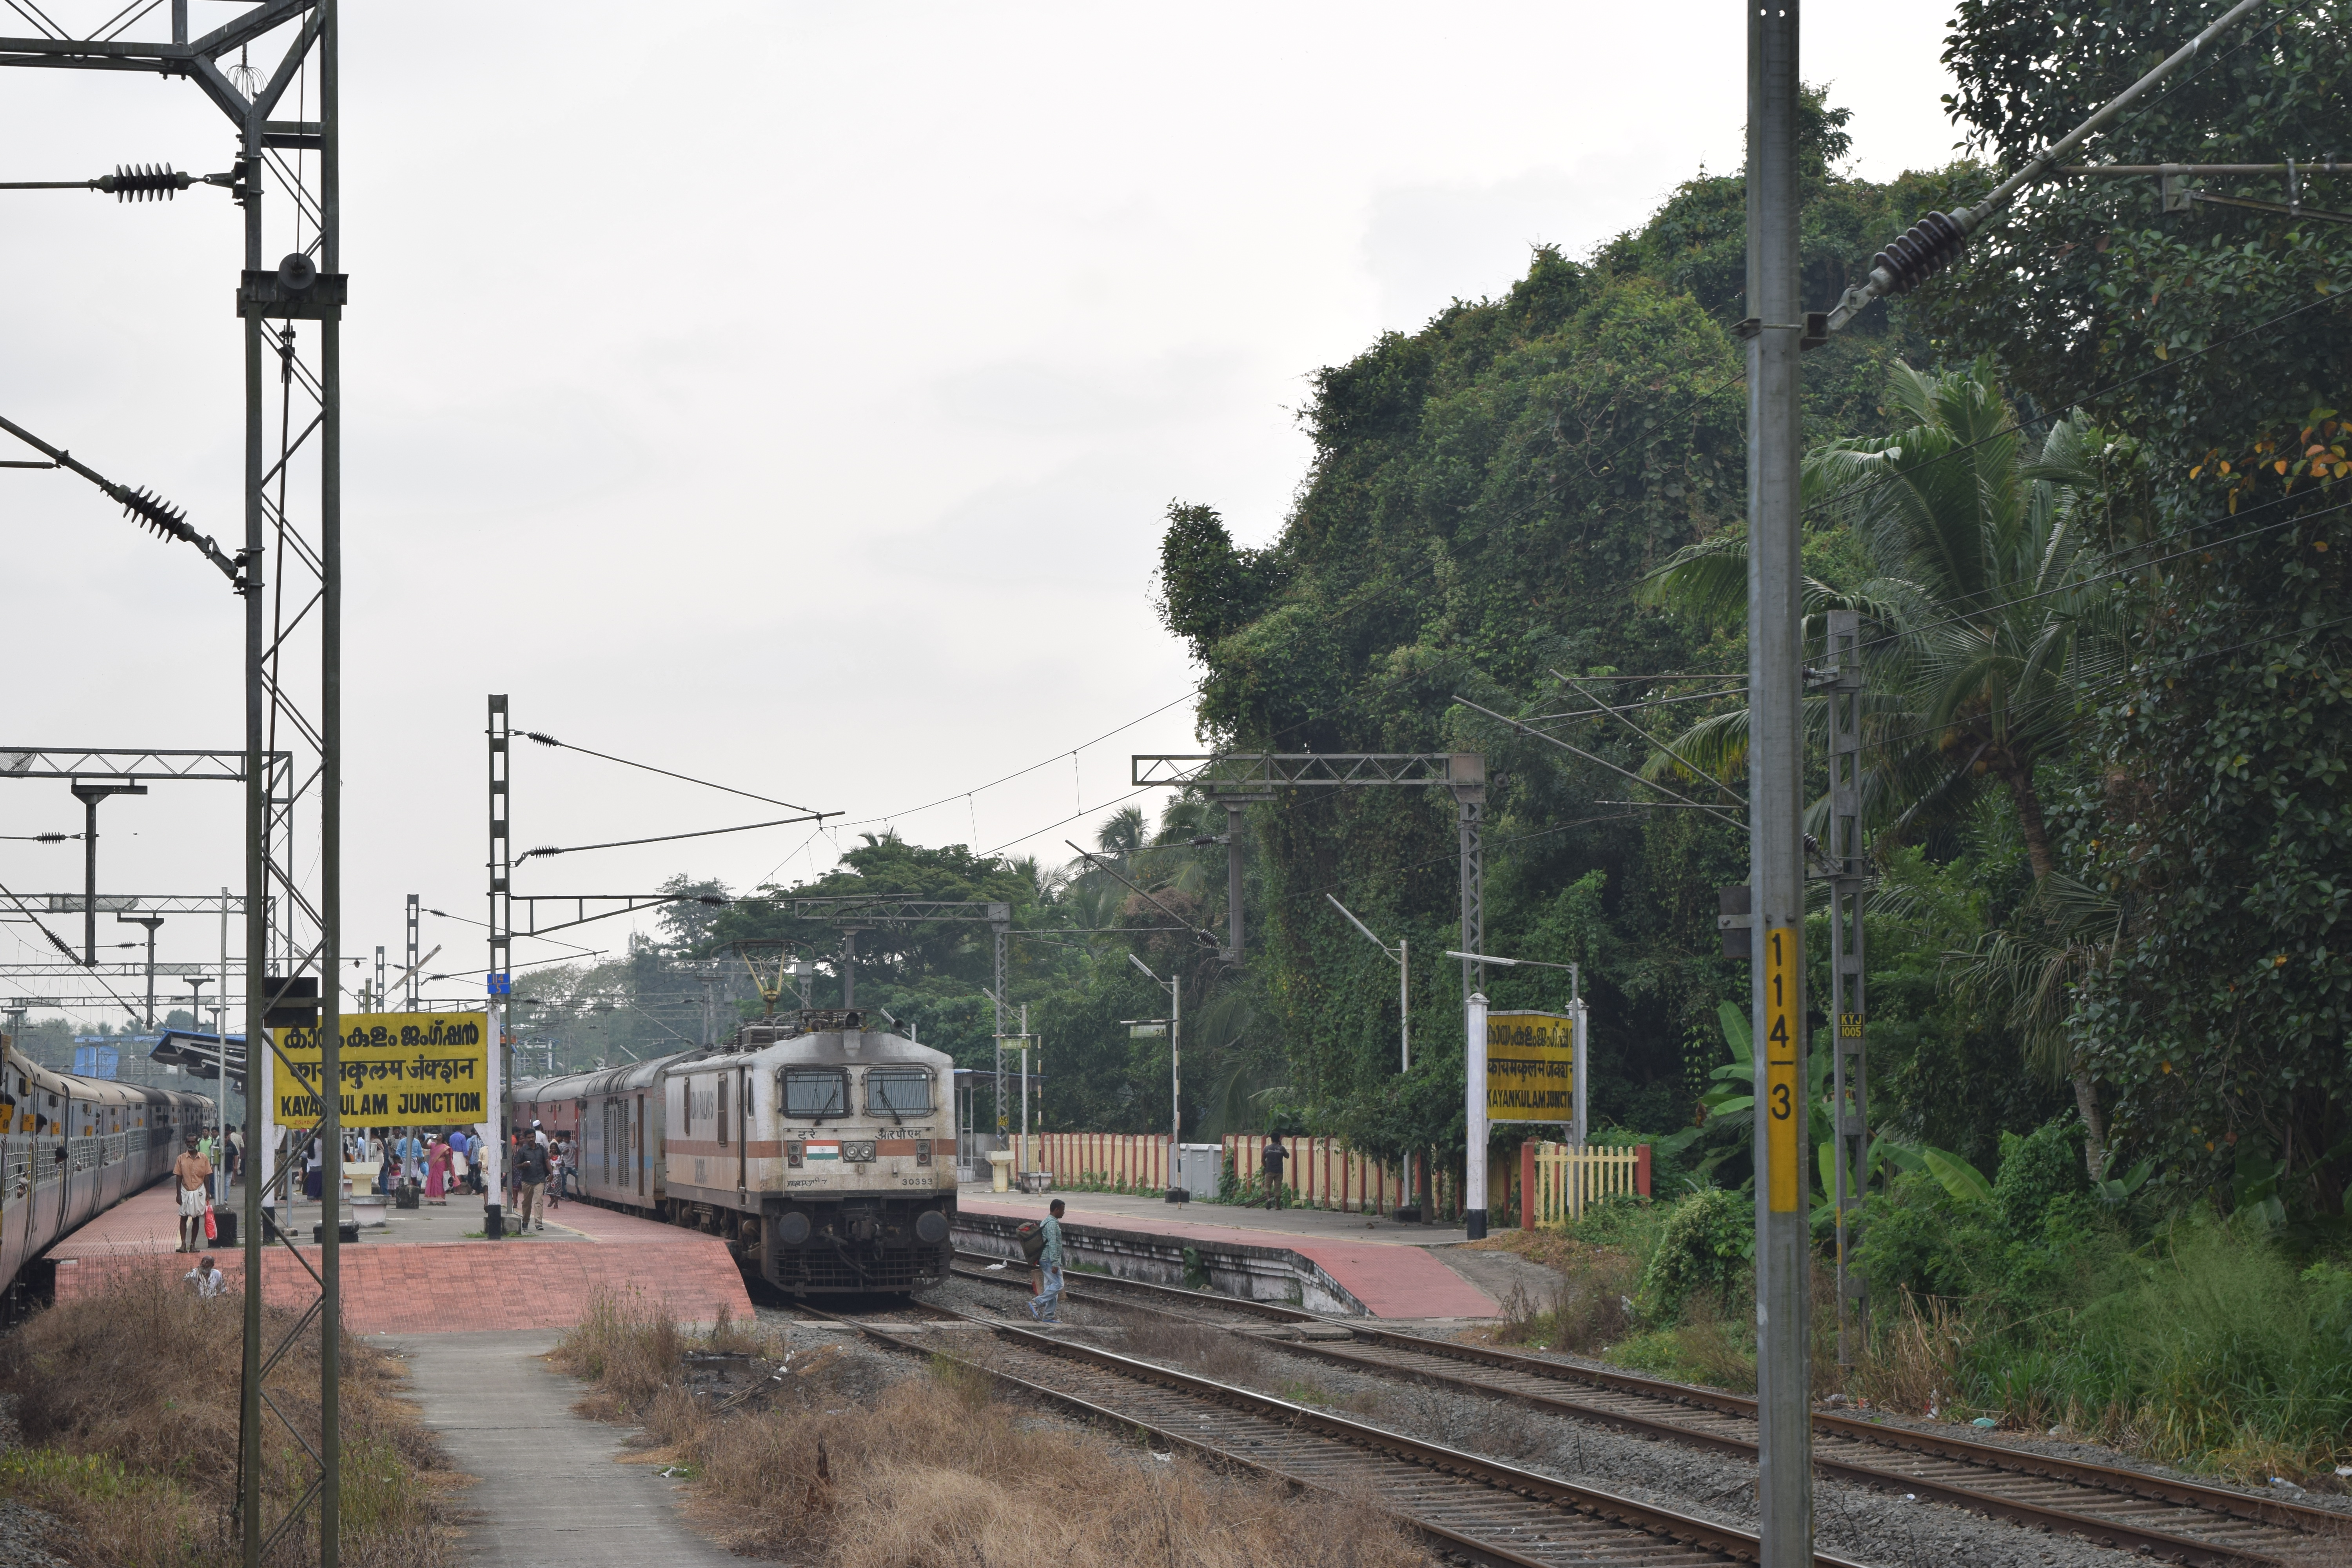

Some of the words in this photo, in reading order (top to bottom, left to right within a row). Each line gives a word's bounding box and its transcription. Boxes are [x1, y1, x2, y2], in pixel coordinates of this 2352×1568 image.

[496, 984, 501, 993] 5
[1841, 1014, 1862, 1024] KYJ
[1842, 1027, 1861, 1037] 1005
[1487, 1089, 1545, 1108] KAYANKULAM
[281, 1093, 388, 1117] KAYAULAM
[397, 1092, 481, 1114] JUNCTION
